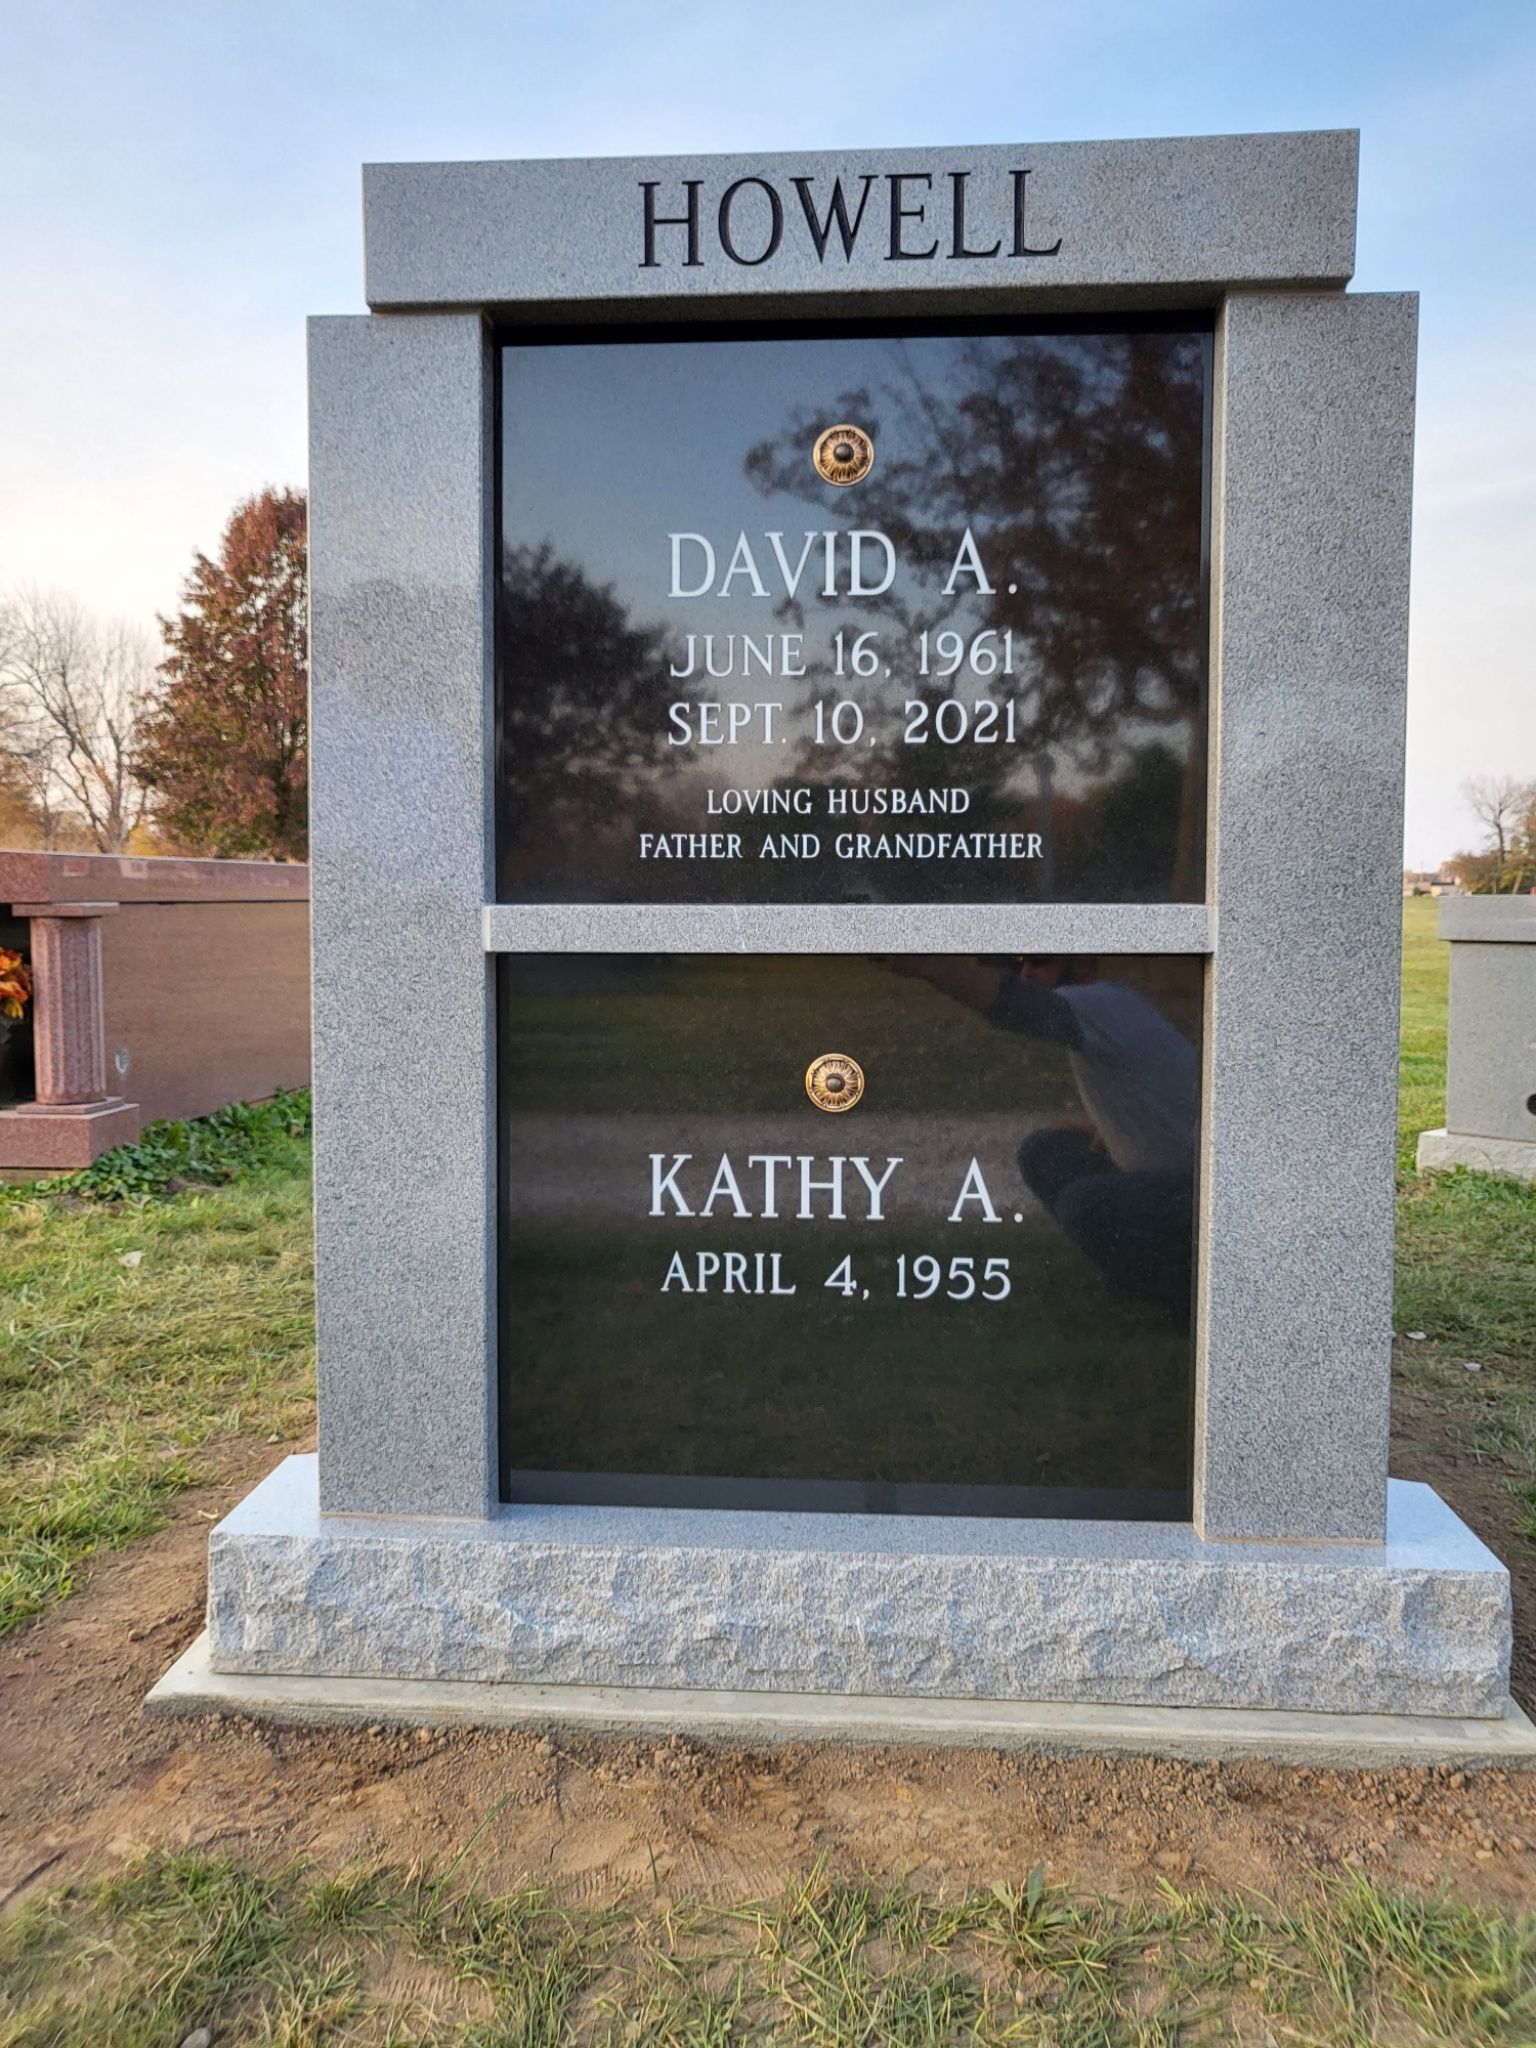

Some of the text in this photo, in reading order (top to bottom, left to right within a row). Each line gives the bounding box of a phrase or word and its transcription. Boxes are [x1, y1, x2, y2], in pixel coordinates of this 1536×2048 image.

[638, 169, 1063, 268] HOWELL
[667, 526, 1019, 599] DAVID A.
[669, 629, 1014, 679] JUNE 16, 1961
[667, 698, 1017, 748] SEPT. 10, 2021
[706, 788, 970, 815] LOVING HUSBAND
[639, 833, 1044, 859] FATHER AND GRANDFATHER
[648, 1152, 1024, 1223] KATHY A.
[660, 1250, 1012, 1300] APRIL 4, 1955
